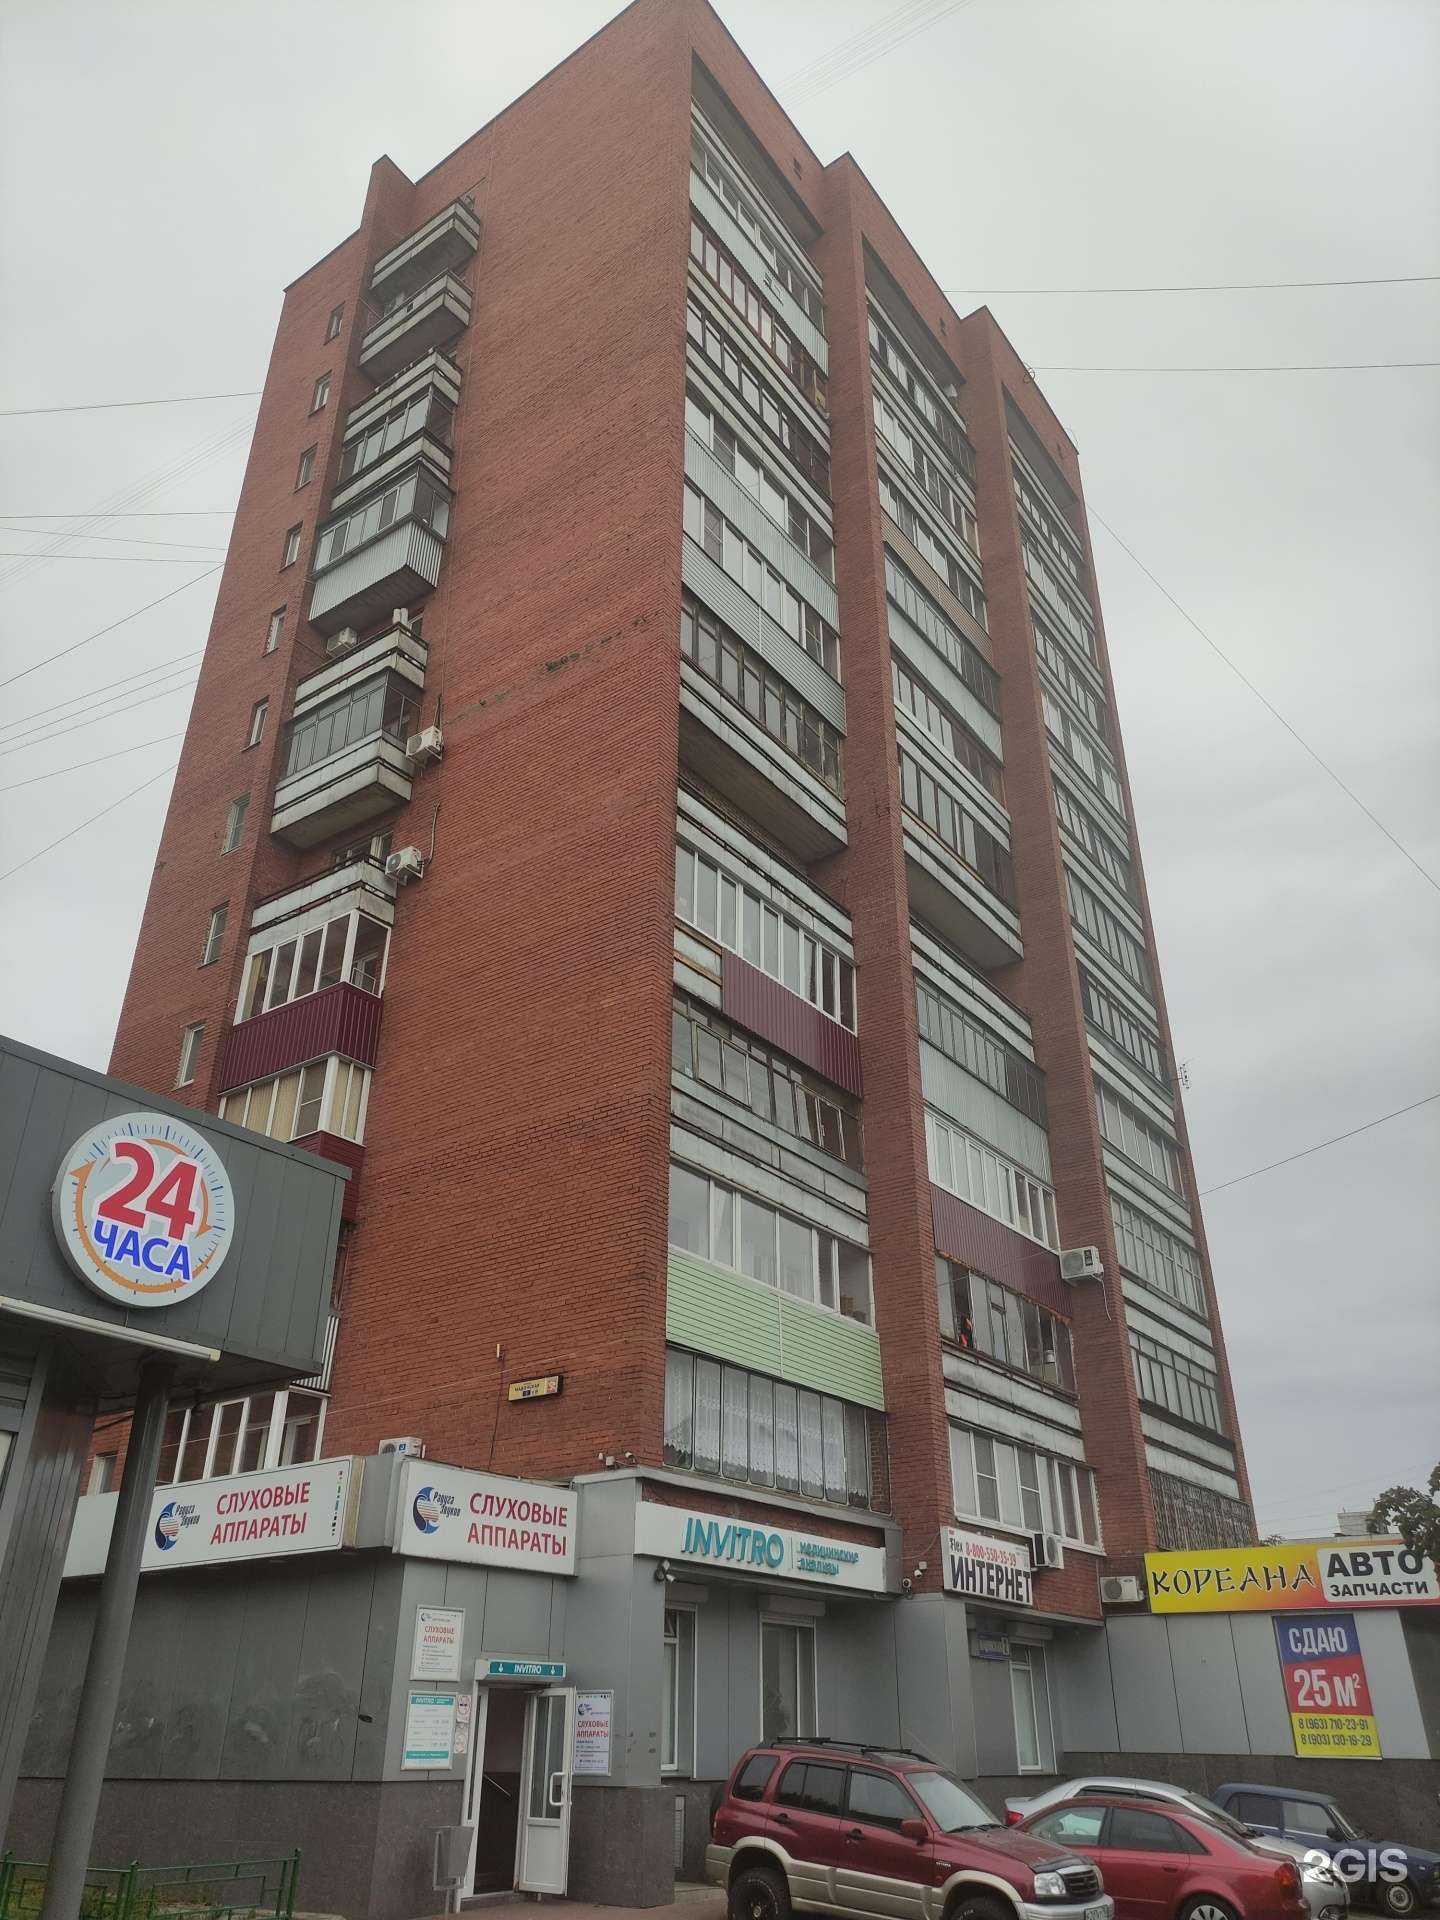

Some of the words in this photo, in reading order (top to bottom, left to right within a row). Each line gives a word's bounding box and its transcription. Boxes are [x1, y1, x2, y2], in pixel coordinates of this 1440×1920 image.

[98, 1142, 198, 1241] 24
[93, 1219, 191, 1281] ЧАСА
[216, 1481, 311, 1515] СЛУХОВЫЕ
[469, 1492, 568, 1527] СЛУХОВЫЕ
[210, 1512, 307, 1545] АППАРАТЫ
[467, 1522, 567, 1556] АППАРАТЫ
[680, 1517, 785, 1568] INVITRO
[949, 1537, 963, 1553] Flex
[950, 1554, 1031, 1603] ИНТЕРНЕТ
[1151, 1563, 1316, 1595] КОРЕАНА
[1326, 1550, 1424, 1578] АВТО
[1330, 1581, 1429, 1597] ЗАПЧАСТИ
[423, 1635, 455, 1644] АППАРАТЫ
[424, 1625, 455, 1635] СЛУХОВЫЕ
[1288, 1626, 1348, 1655] СДАЮ
[514, 1663, 542, 1674] INVITRO
[576, 1730, 609, 1738] АППАРАТЫ
[577, 1720, 609, 1728] СЛУХОВЫЕ
